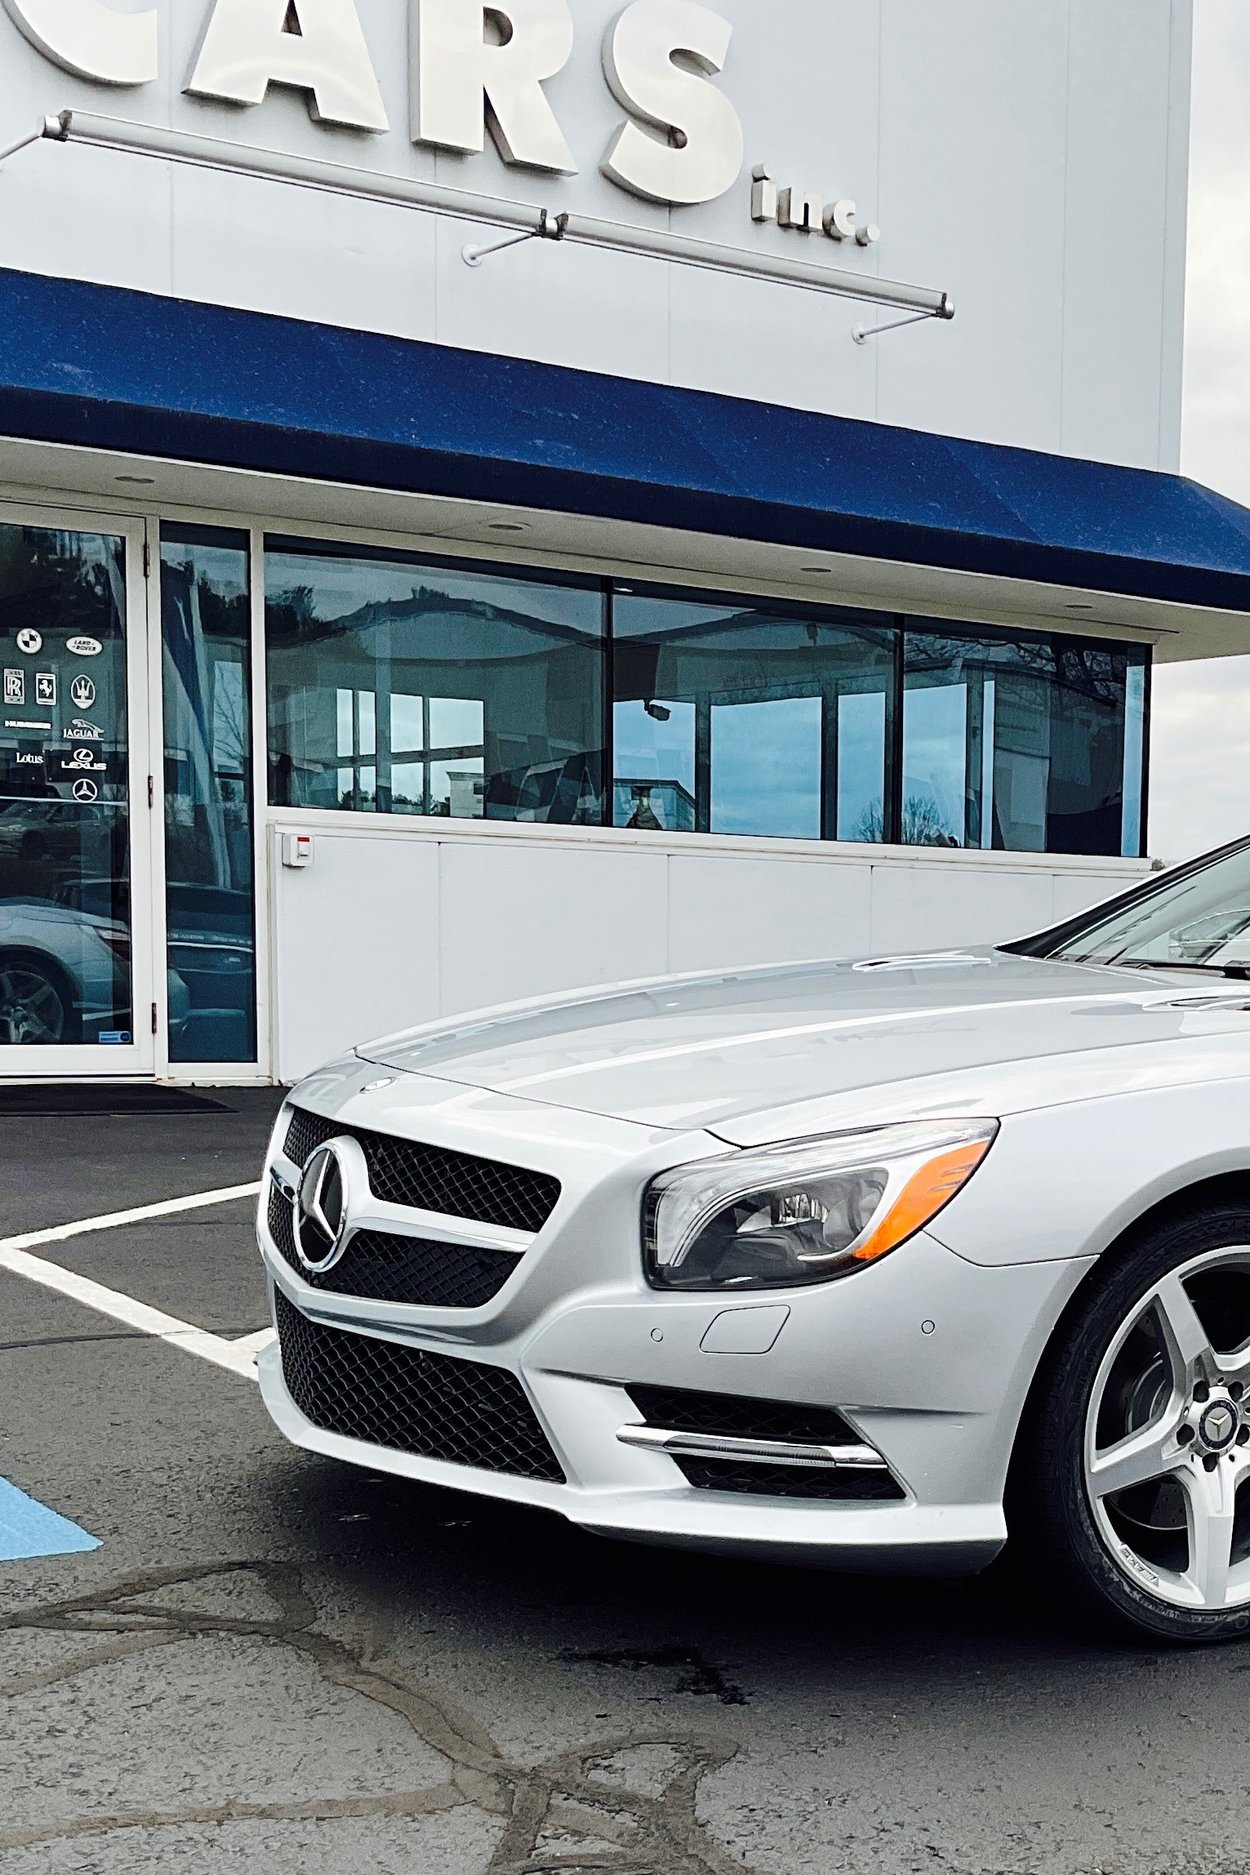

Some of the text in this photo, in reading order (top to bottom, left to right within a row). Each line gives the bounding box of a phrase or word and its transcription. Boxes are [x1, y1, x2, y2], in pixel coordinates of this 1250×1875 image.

[751, 163, 881, 247] inc.
[63, 728, 99, 738] JAGUAR
[16, 752, 44, 764] Lotus
[61, 761, 107, 770] LEXUS
